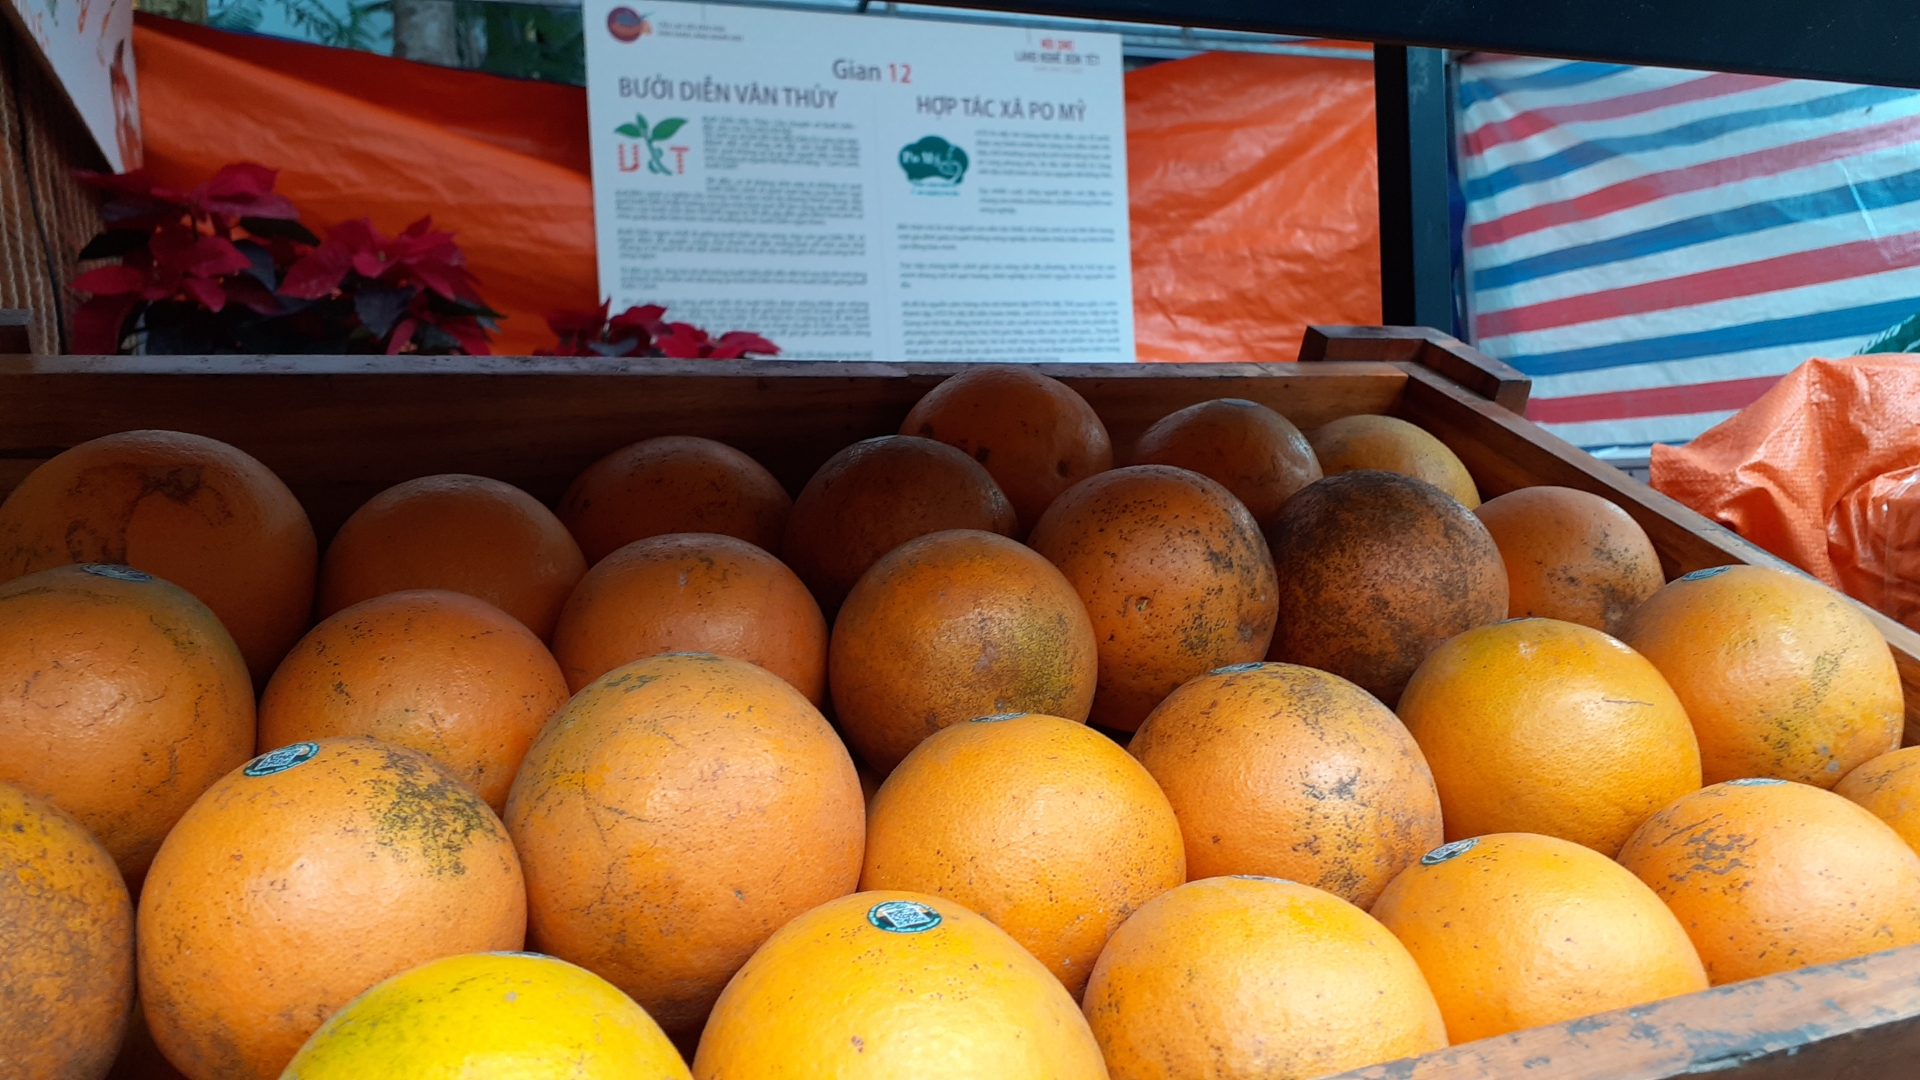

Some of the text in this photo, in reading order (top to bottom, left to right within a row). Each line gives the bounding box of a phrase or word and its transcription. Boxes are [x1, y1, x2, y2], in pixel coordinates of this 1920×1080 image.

[831, 58, 912, 84] Gian 12
[618, 73, 674, 100] BƯỞI
[679, 75, 730, 103] DIỄN
[916, 95, 958, 120] HỢP
[960, 94, 996, 118] TÁC
[1029, 102, 1055, 120] PO
